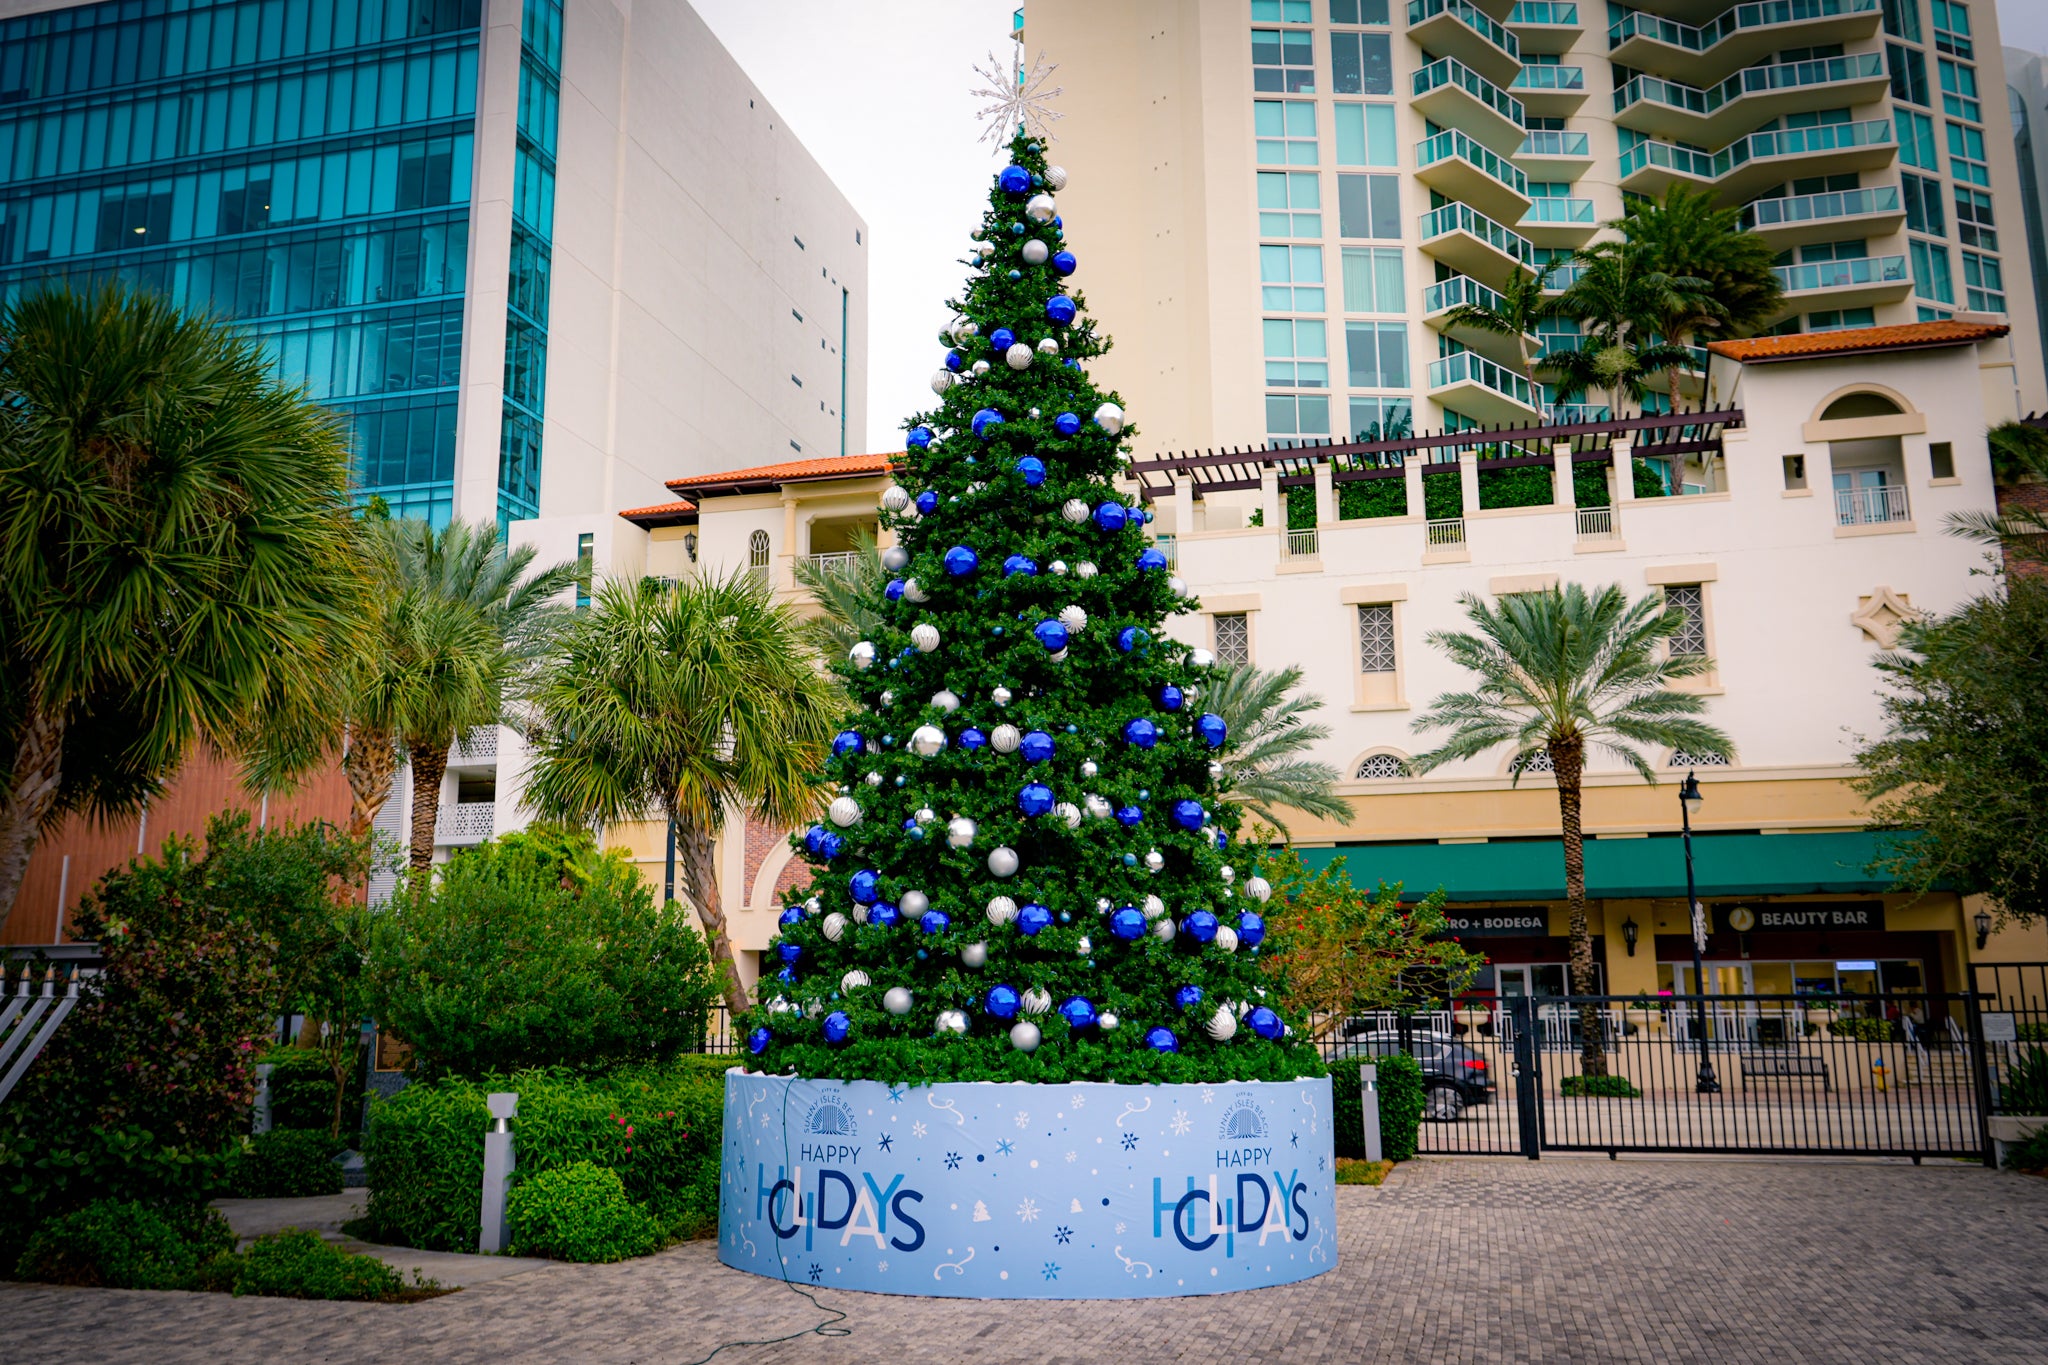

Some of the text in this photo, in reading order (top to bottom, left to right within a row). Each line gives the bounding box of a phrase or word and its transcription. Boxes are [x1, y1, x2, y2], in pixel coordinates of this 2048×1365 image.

[1483, 917, 1543, 929] BODEGA
[1761, 910, 1868, 926] BEAUTY BAR
[803, 1095, 858, 1137] SUNNY ISLES BEACH
[1218, 1099, 1269, 1140] SUNNY ISLES BEACH
[801, 1143, 862, 1165] HAPPY
[1216, 1147, 1272, 1168] HAPPY
[756, 1162, 926, 1252] HOLIDAYS
[1153, 1168, 1309, 1258] HOLIDAYS
